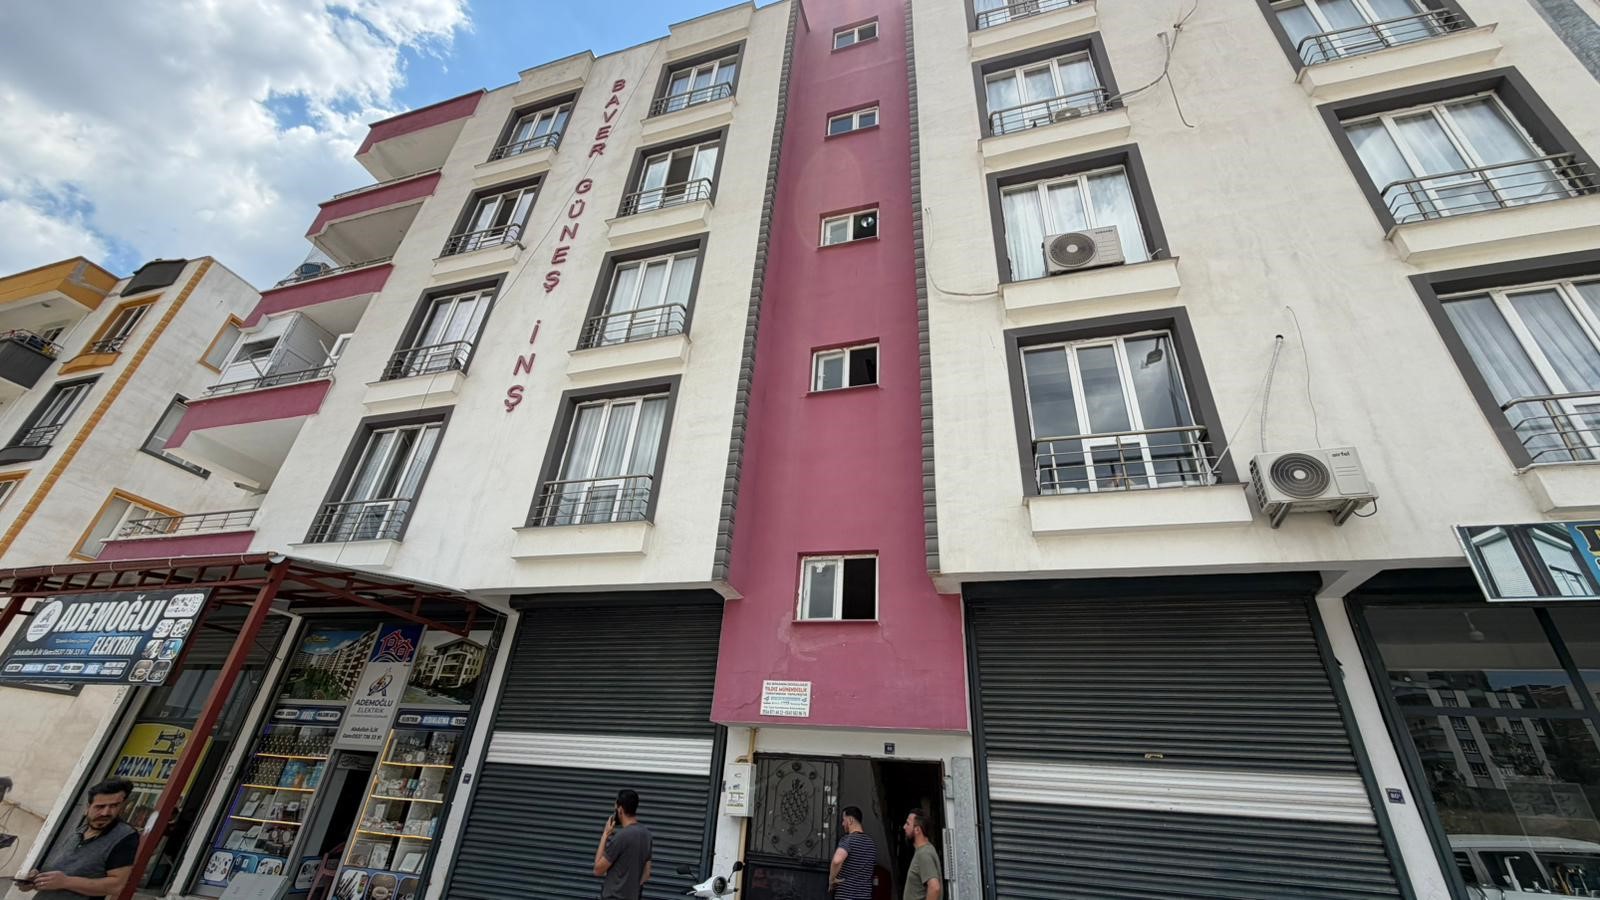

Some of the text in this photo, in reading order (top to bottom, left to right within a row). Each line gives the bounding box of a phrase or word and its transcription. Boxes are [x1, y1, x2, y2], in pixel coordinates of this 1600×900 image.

[504, 79, 626, 413] BAVER GÜNEŞ İNŞ
[52, 594, 168, 632] ADEMOĞLU
[88, 635, 143, 655] ELEKTRİK
[354, 698, 393, 707] ADEMOĞLU
[114, 756, 178, 779] BAYAN TE
